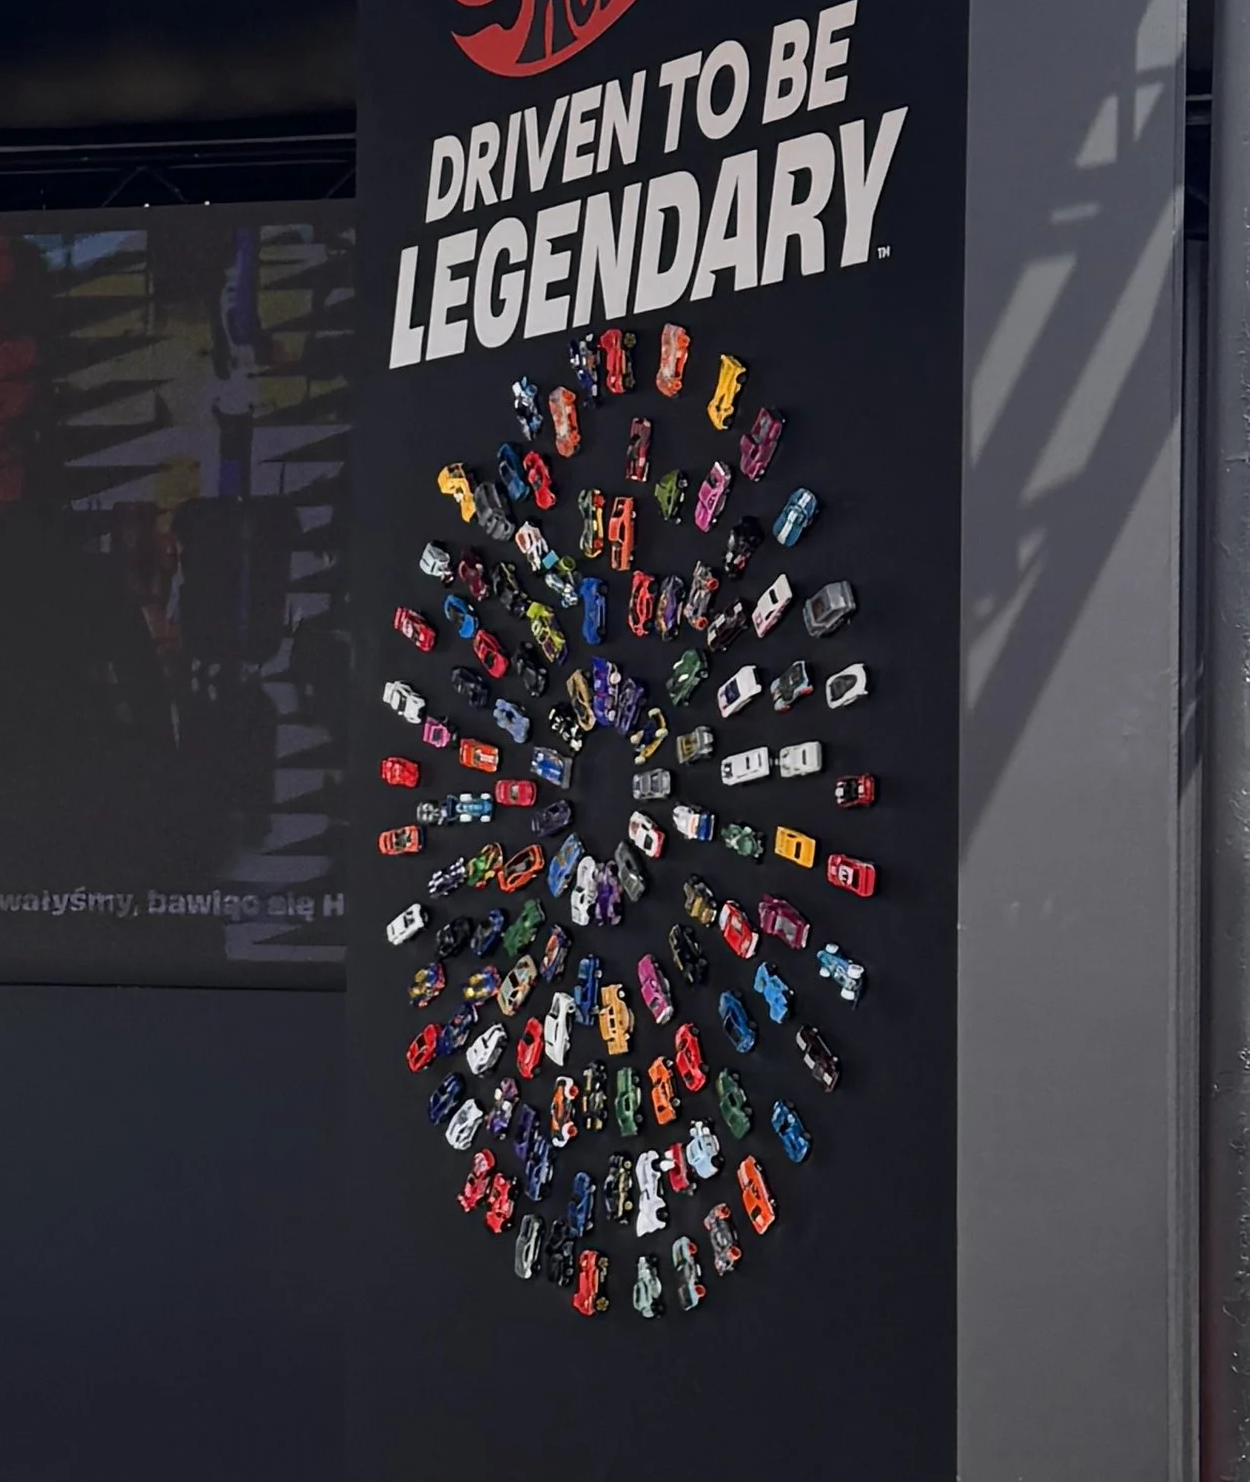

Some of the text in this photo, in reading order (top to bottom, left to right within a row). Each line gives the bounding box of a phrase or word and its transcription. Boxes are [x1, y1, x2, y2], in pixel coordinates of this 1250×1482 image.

[426, 0, 858, 223] DRIVEN TO BE
[389, 106, 909, 369] LEGENDARY
